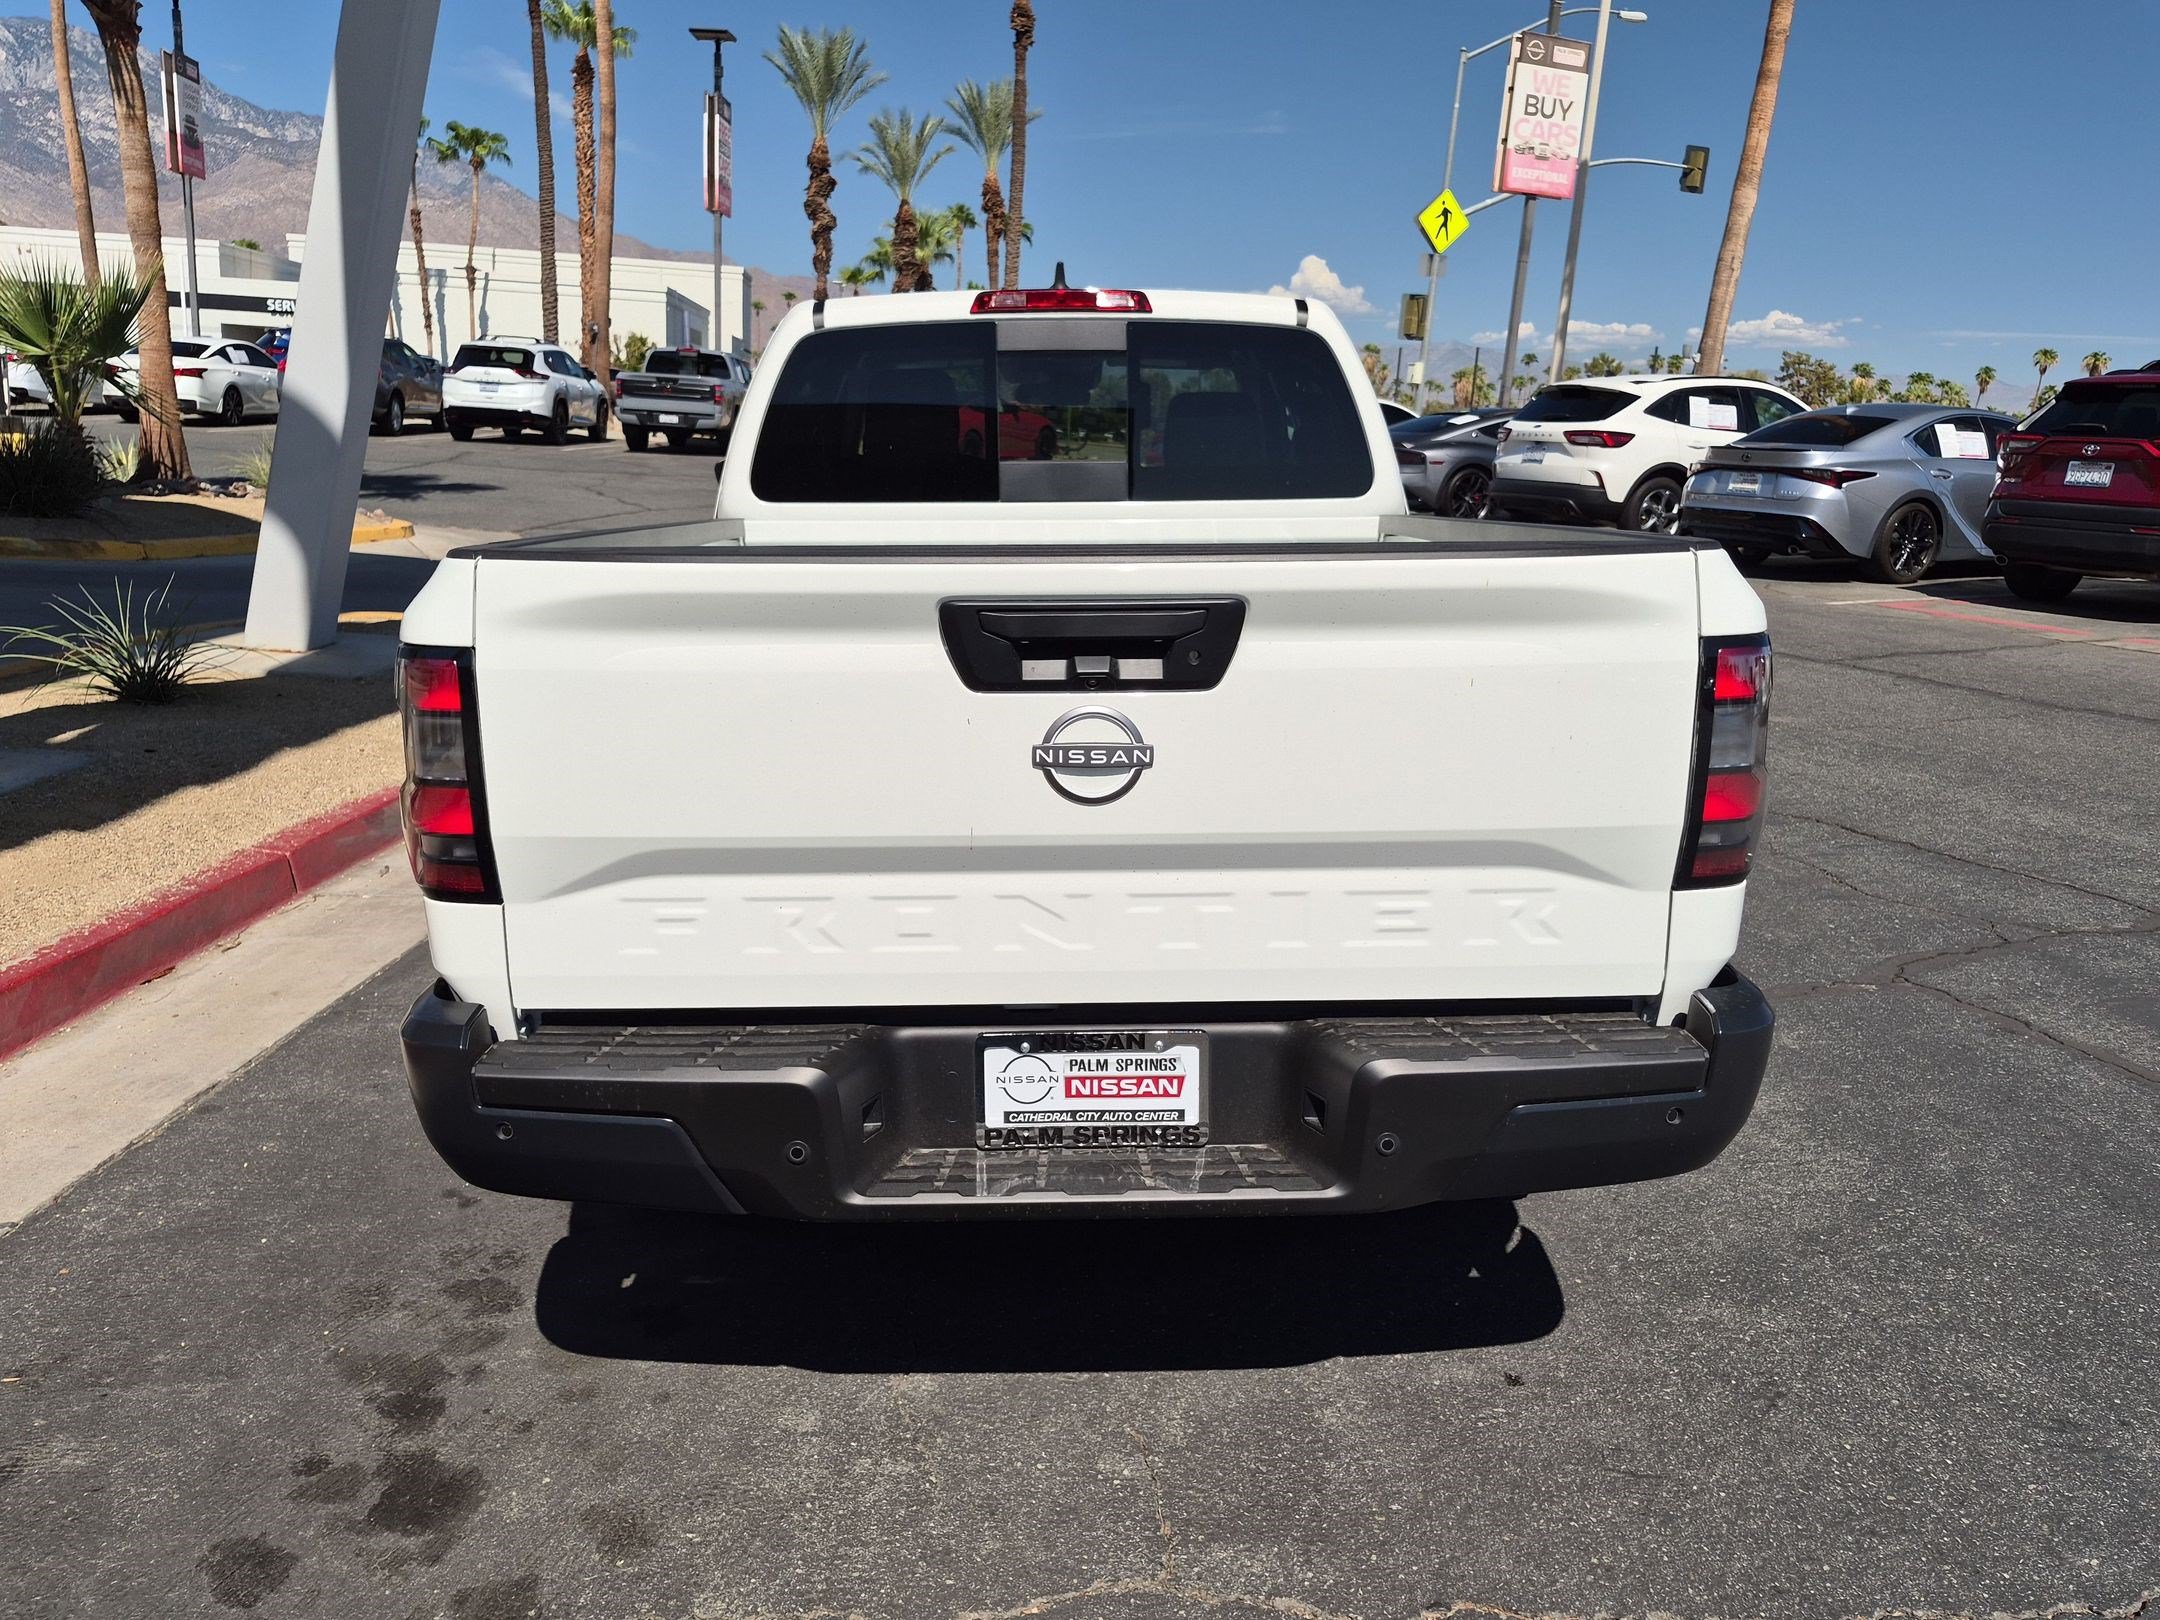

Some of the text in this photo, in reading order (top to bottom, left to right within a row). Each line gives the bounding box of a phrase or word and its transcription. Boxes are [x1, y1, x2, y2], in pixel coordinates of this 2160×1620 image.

[1532, 69, 1572, 98] WE
[1524, 93, 1574, 121] BUY
[1513, 118, 1579, 148] CARS
[1035, 748, 1151, 764] NISSAN
[616, 887, 1563, 955] FRONTIER
[1039, 1033, 1146, 1052] NISSAN
[1069, 1057, 1177, 1072] PALM SPRINGS
[996, 1075, 1059, 1084] NISSAN
[1071, 1078, 1179, 1095] NISSAN
[1009, 1111, 1179, 1122] CATHEDRAL CITY AUTO CENTER
[984, 1125, 1201, 1146] PALM SPRINGS
